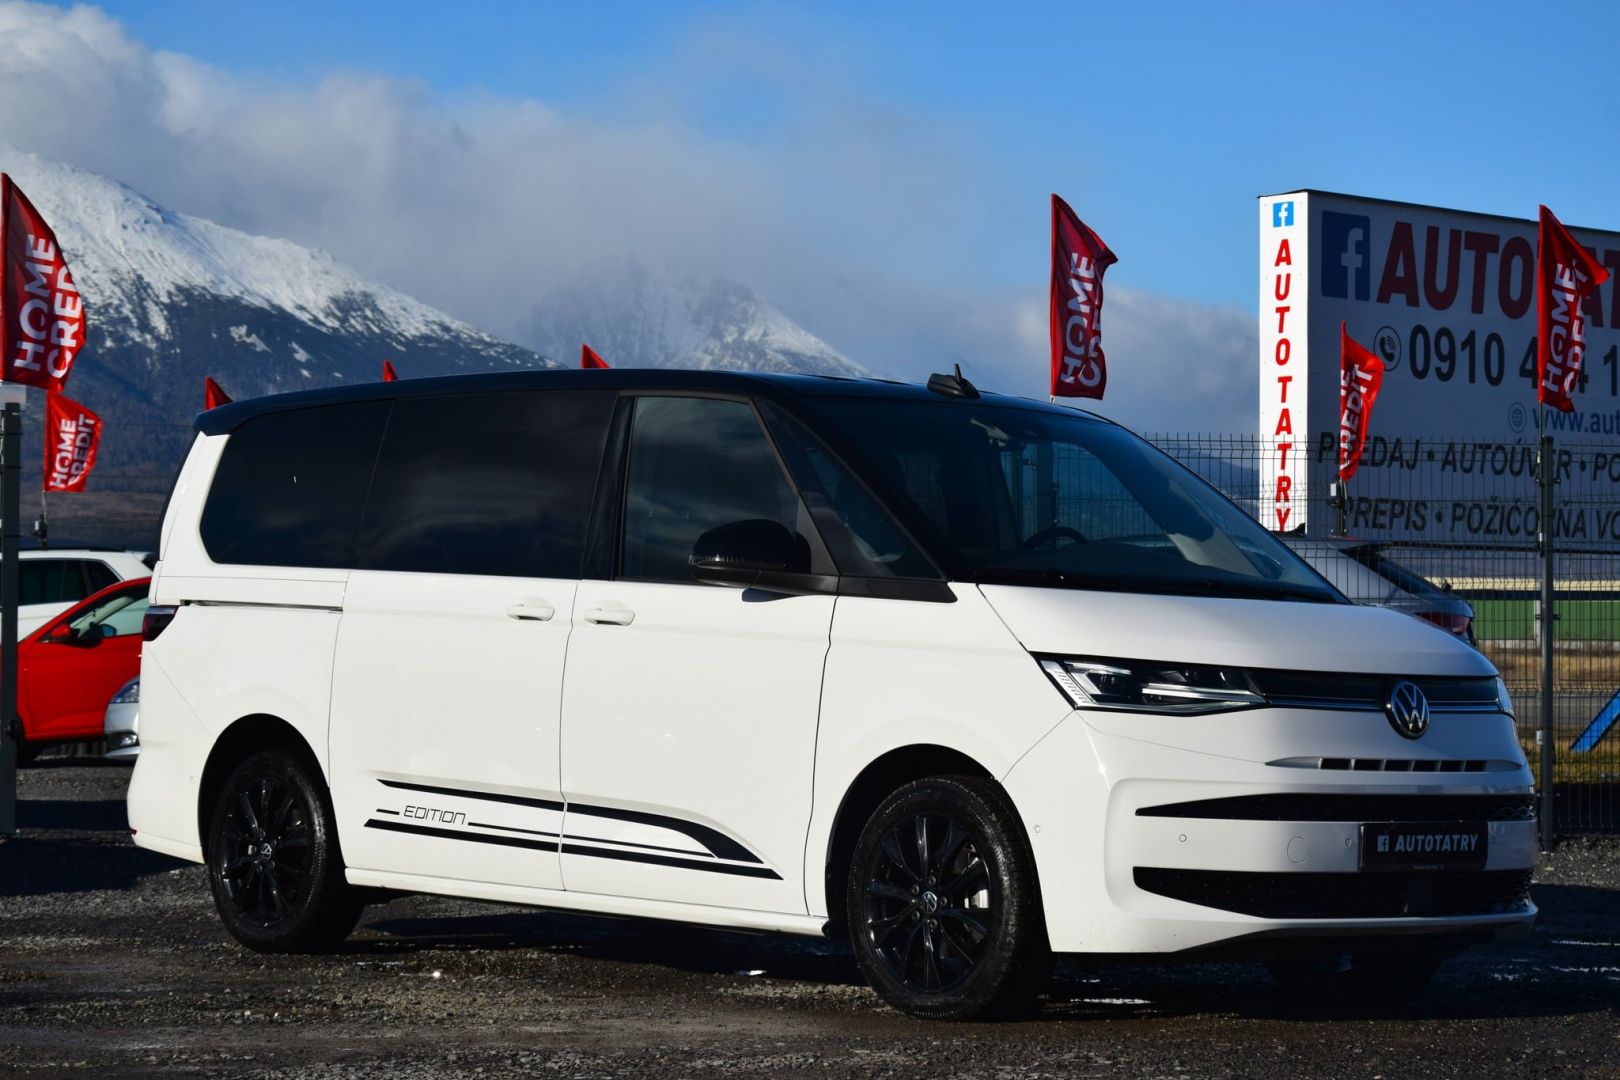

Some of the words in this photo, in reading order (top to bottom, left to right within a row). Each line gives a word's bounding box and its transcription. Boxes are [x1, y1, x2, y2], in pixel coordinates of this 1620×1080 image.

[13, 234, 57, 372] HOME
[1376, 221, 1620, 328] AUTO
[1060, 252, 1095, 384] HOME
[1541, 263, 1577, 392] HOME
[1274, 239, 1293, 532] AUTOTATRY
[1409, 325, 1505, 387] 0910
[48, 418, 77, 489] HOME
[1318, 432, 1420, 470] PDAJ
[1441, 438, 1572, 480] AUTOÚVR
[1451, 496, 1587, 539] POŽIČOŇA
[403, 805, 466, 825] EDITION
[1394, 834, 1480, 853] AUTOTATRY
